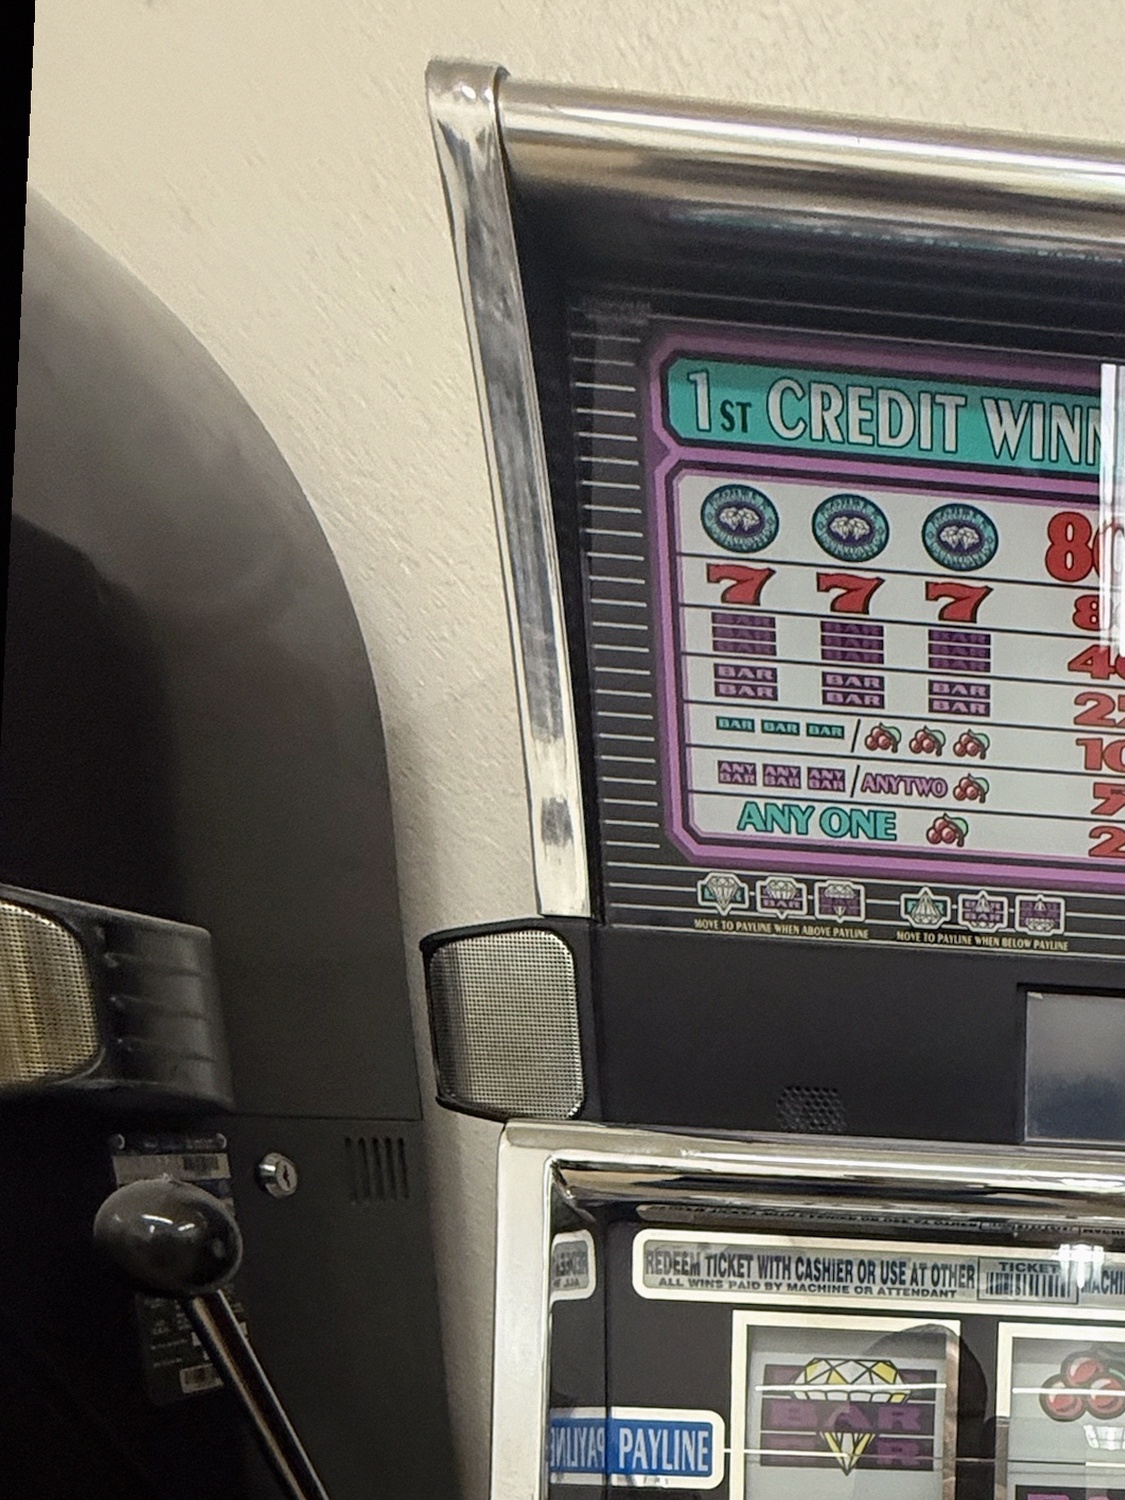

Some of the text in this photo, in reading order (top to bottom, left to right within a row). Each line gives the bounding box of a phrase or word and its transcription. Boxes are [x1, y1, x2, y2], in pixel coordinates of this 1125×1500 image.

[766, 377, 966, 454] CREDIT
[706, 563, 994, 624] 7 7 7
[737, 801, 814, 835] ANY
[819, 806, 897, 841] ONE
[694, 919, 869, 940] MOVE TO PAYLINE WHEN ABOVE PAYLINE
[896, 930, 1069, 951] MOVE TO PAYLINE WHEN BELOW PAYLINE
[646, 1250, 975, 1289] REDEEM TICKET WITH CASHIER OR USE AT OTHER
[999, 1260, 1060, 1274] TICKET
[659, 1277, 957, 1299] ALL WINS PAID BY MACHINE OR ATTENDANT
[618, 1427, 709, 1472] PAYLINE
